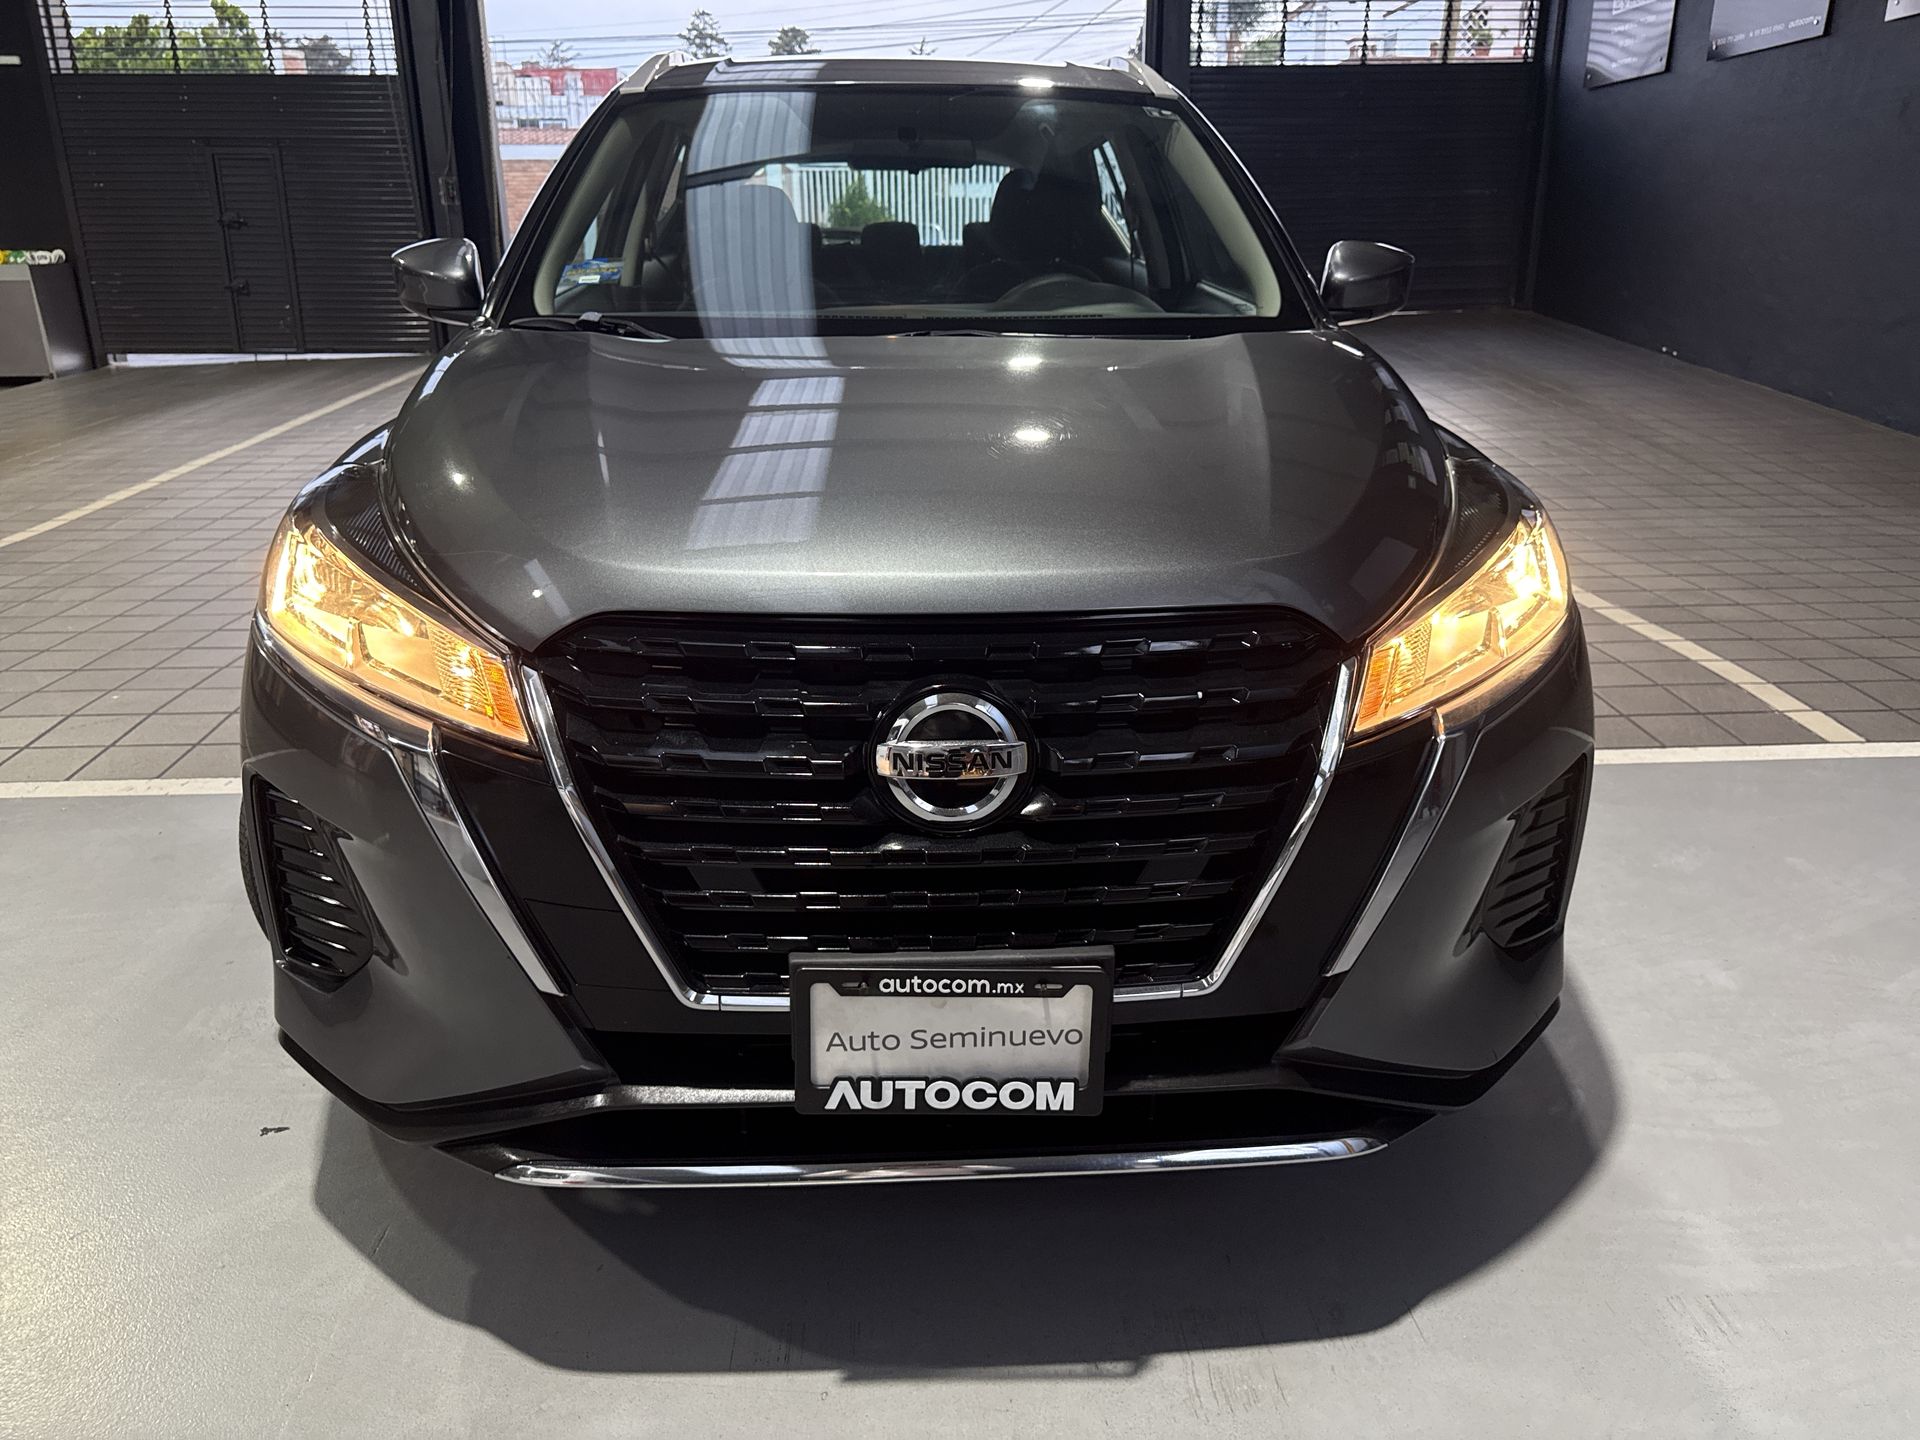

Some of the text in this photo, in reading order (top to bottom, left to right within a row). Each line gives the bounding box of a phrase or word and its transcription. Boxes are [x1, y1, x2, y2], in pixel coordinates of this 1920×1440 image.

[892, 750, 1012, 772] NISSAN
[878, 975, 1025, 994] autocom.mx
[826, 1026, 1084, 1053] Auto Seminuevo
[824, 1080, 1075, 1111] AUTOCOM
